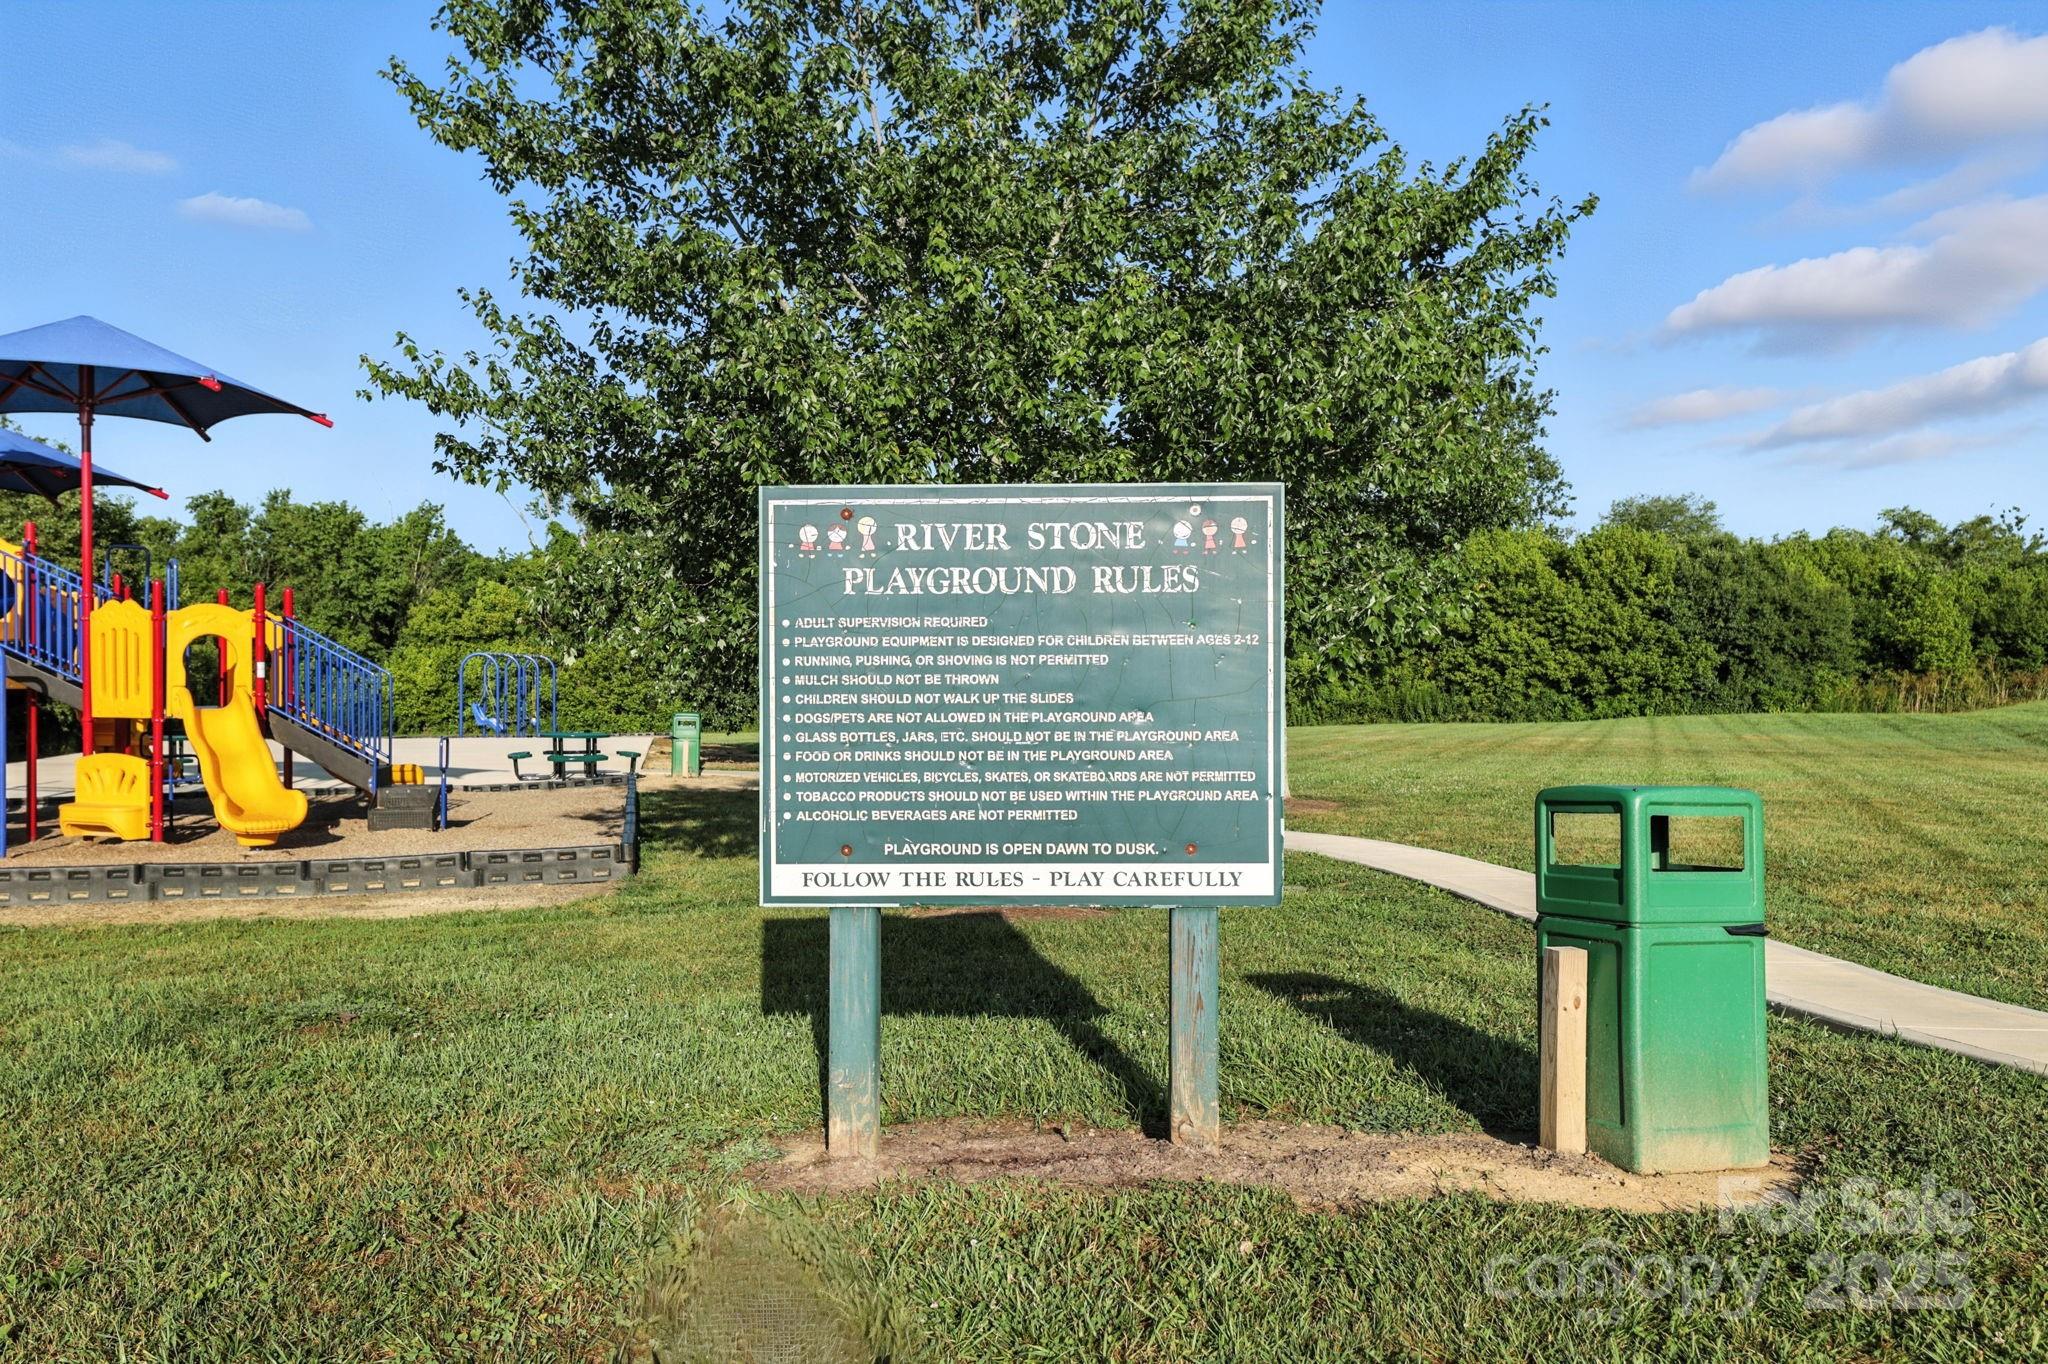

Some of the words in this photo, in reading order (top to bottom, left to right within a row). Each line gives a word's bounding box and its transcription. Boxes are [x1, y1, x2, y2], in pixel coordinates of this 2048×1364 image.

[896, 523, 1009, 551] RIVER
[1027, 521, 1146, 550] STONE
[842, 566, 1077, 596] PLAYGROUND
[1093, 564, 1200, 593] RULES
[795, 616, 835, 628] ADULT
[838, 616, 921, 628] SUPERVISION
[924, 616, 988, 628] REQUIRED
[795, 636, 878, 648] PLAYGROUND
[882, 635, 952, 647] EQUIPMENT
[957, 635, 969, 647] IS
[972, 635, 1035, 647] DESIGNED
[1039, 635, 1064, 647] FOR
[1067, 634, 1131, 646] CHILDREN
[1133, 634, 1194, 646] BETWEEN
[1196, 634, 1231, 646] AGES
[1234, 634, 1260, 646] 2-12
[795, 655, 852, 669] RUNNING,
[856, 655, 912, 669] PUSHING,
[915, 654, 934, 666] OR
[937, 654, 993, 666] SHOVING
[996, 654, 1007, 666] IS
[1011, 654, 1036, 666] NOT
[1039, 654, 1109, 666] PERMITTED
[795, 674, 838, 686] MULCH
[842, 674, 892, 686] SHOULD
[896, 673, 921, 685] NOT
[925, 673, 941, 685] BE
[945, 673, 999, 685] THROWN
[795, 693, 858, 705] CHILDREN
[861, 693, 912, 705] SHOULD
[915, 693, 940, 705] NOT
[944, 692, 979, 704] WALK
[983, 692, 1000, 704] UP
[1003, 692, 1027, 704] THE
[1030, 692, 1074, 704] SLIDES
[795, 712, 865, 724] DOGS/PETS
[868, 712, 893, 724] ARE
[897, 712, 922, 724] NOT
[925, 712, 985, 724] ALLOWED
[989, 712, 1000, 724] IN
[1004, 712, 1029, 724] THE
[1032, 711, 1116, 723] PLAYGROUND
[1119, 711, 1154, 723] AREA
[796, 731, 837, 743] GLASS
[840, 731, 899, 745] BOTTLES,
[902, 731, 937, 745] JARS,
[941, 731, 968, 743] ETC.
[971, 731, 1022, 743] SHOULD
[1026, 731, 1051, 743] NOT
[1054, 731, 1071, 743] BE
[1074, 731, 1086, 743] IN
[1089, 730, 1114, 742] THE
[1117, 730, 1201, 742] PLAYGROUND
[1204, 730, 1239, 742] AREA
[796, 750, 830, 762] FOOD
[833, 750, 852, 762] OR
[855, 750, 901, 762] DRINKS
[904, 750, 955, 762] SHOULD
[959, 750, 984, 762] NOT
[987, 750, 1004, 762] BE
[1008, 750, 1019, 762] IN
[1023, 750, 1047, 762] THE
[1051, 750, 1135, 762] PLAYGROUND
[1138, 750, 1173, 762] AREA
[796, 771, 860, 783] MOTORIZED
[863, 771, 921, 785] VEHICLES,
[924, 771, 981, 785] BICYCLES,
[985, 771, 1031, 785] SKATES,
[1034, 771, 1051, 783] OR
[1053, 771, 1137, 783] SKATEBOARDS
[1139, 770, 1163, 782] ARE
[1166, 770, 1189, 782] NOT
[1192, 770, 1256, 782] PERMITTED
[796, 790, 856, 802] TOBACCO
[859, 790, 925, 802] PRODUCTS
[929, 790, 978, 802] SHOULD
[982, 790, 1006, 802] NOT
[1010, 790, 1026, 802] BE
[1030, 790, 1062, 802] USED
[1065, 790, 1107, 802] WITHIN
[1111, 790, 1135, 802] THE
[1139, 790, 1222, 802] PLAYGROUND
[1225, 790, 1259, 802] AREA
[796, 809, 868, 821] ALCOHOLIC
[871, 809, 947, 821] BEVERAGES
[950, 809, 975, 821] ARE
[979, 809, 1004, 821] NOT
[1008, 809, 1078, 821] PERMITTED
[884, 843, 982, 855] PLAYGROUND
[986, 843, 999, 855] IS
[1003, 843, 1042, 855] OPEN
[1046, 843, 1088, 855] DAWN
[1092, 843, 1112, 855] TO
[1116, 843, 1159, 855] DUSK.
[802, 872, 891, 888] FOLLOW
[899, 872, 946, 887] THE
[956, 872, 1024, 887] RULES
[1050, 872, 1104, 887] PLAY
[1113, 871, 1242, 887] CAREFULLY
